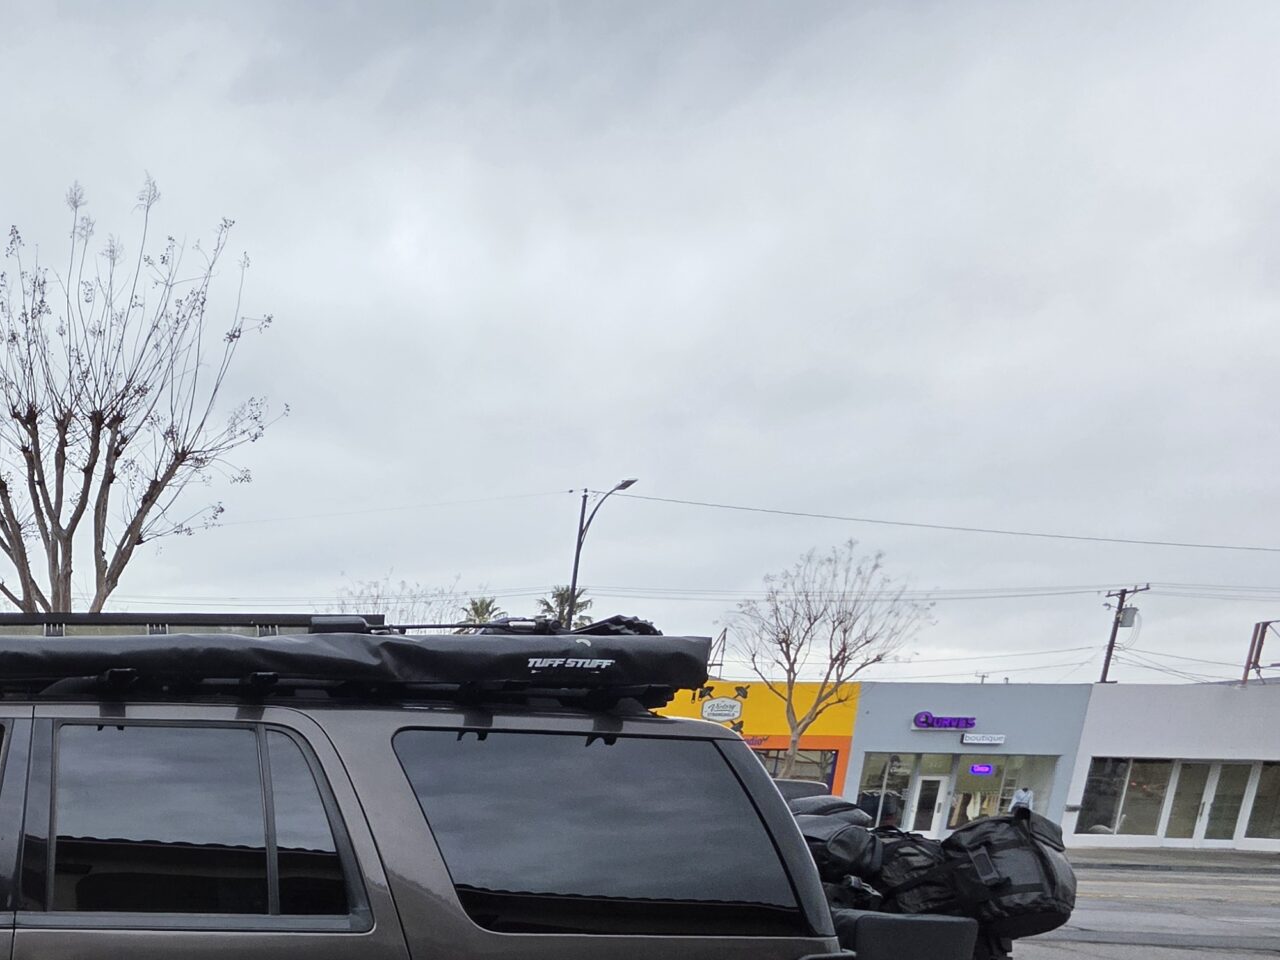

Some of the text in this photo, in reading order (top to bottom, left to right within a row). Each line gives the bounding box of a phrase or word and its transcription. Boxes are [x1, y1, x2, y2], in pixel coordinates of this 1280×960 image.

[527, 658, 616, 669] TUFF STUFF
[964, 734, 1005, 742] boutique
